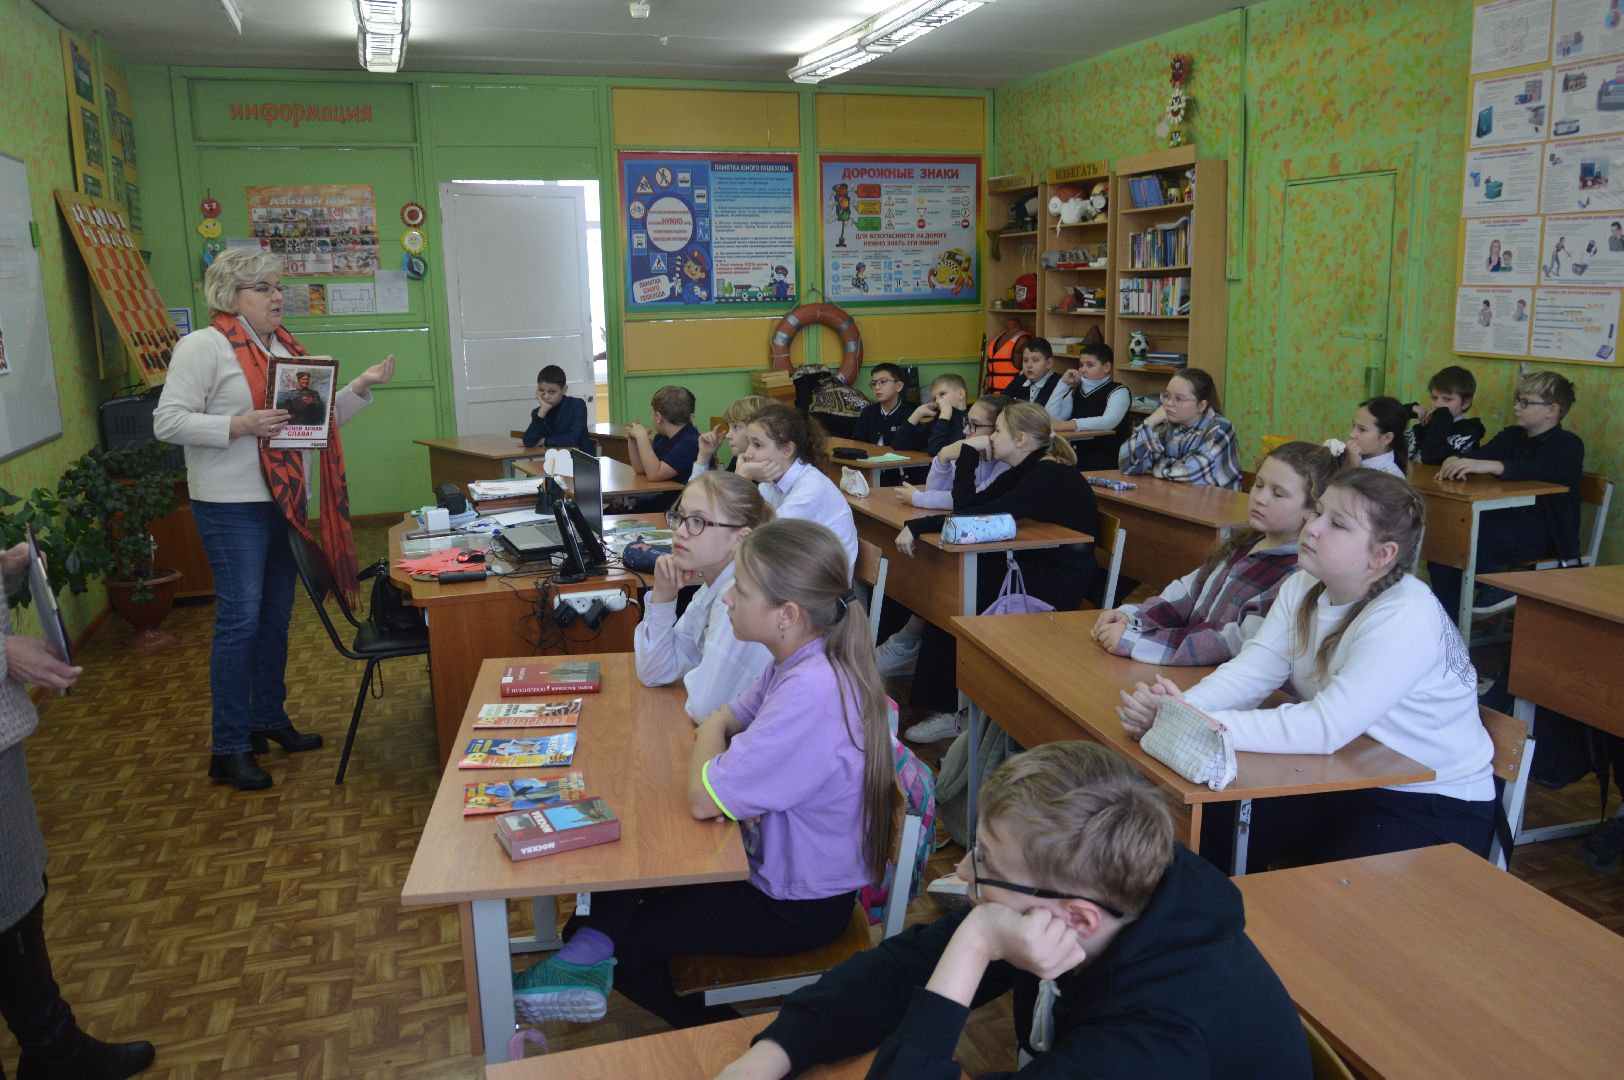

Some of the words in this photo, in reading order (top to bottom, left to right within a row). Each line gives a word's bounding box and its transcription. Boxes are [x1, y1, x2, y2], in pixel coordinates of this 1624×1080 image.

[229, 102, 373, 128] информация
[842, 167, 914, 180] ДОРОЖНЫЕ
[920, 168, 959, 179] ЗНАКИ
[1055, 163, 1099, 180] ИЗБЕГАТЬ
[269, 194, 321, 205] АЗБУКА
[869, 232, 915, 240] БЕЗОПАСНОСТИ
[290, 262, 306, 273] 01
[639, 278, 661, 288] ПАМЯТКА
[643, 285, 660, 294] ЮНОГО
[640, 291, 666, 302] ПЕШЕХОДА
[520, 841, 556, 855] МОСКВА
